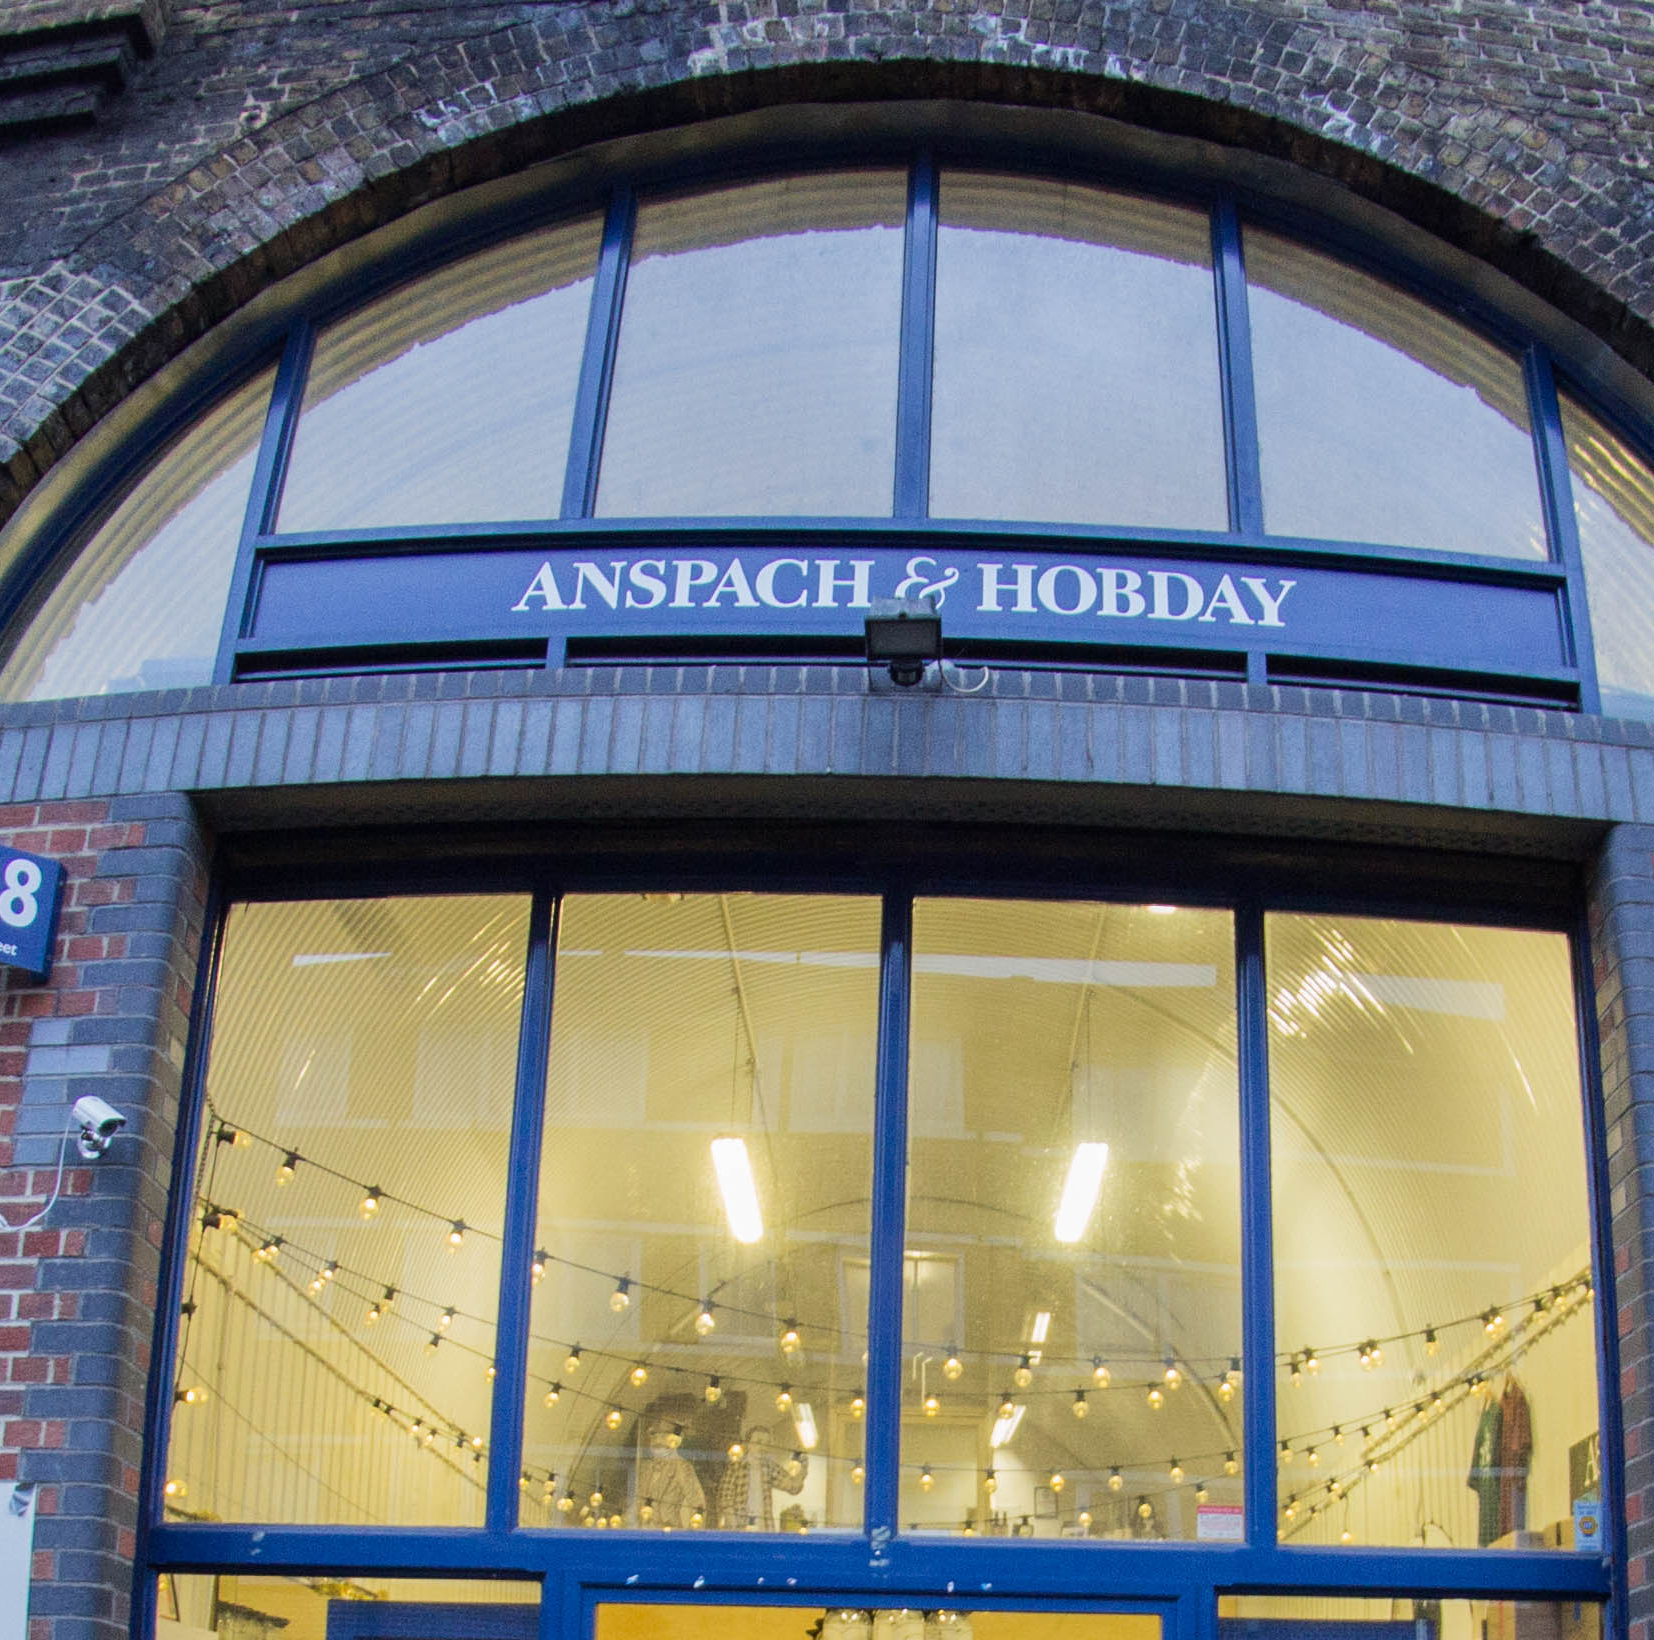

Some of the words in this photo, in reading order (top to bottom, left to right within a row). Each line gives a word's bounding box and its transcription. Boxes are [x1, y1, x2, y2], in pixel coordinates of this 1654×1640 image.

[511, 557, 875, 611] ANSPACH
[894, 556, 960, 609] &
[977, 563, 1297, 627] HOBDAY
